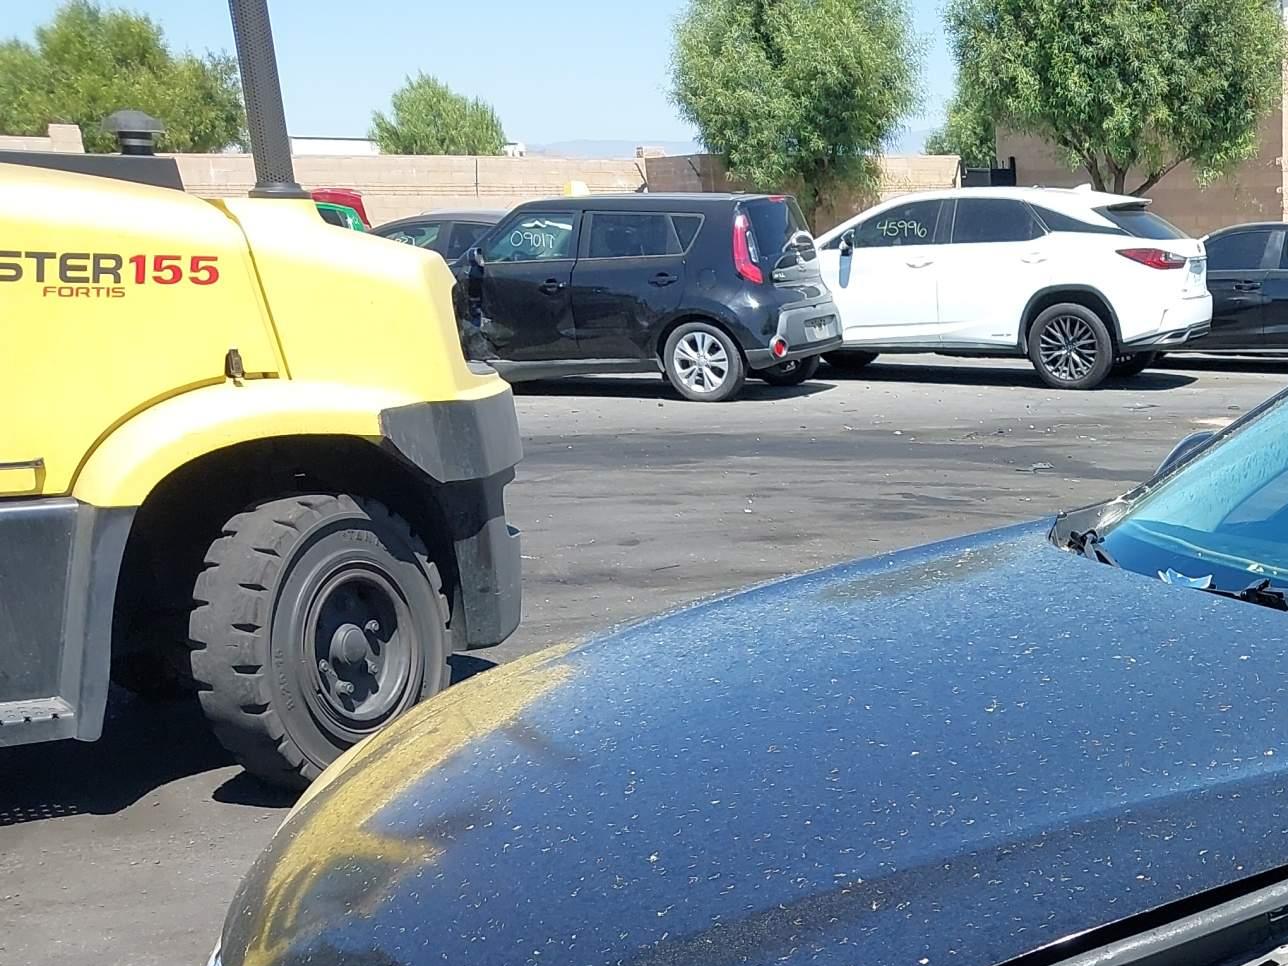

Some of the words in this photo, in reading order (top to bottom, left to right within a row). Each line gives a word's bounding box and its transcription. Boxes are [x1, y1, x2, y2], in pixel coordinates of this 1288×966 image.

[876, 219, 928, 238] 45996
[129, 254, 219, 286] 155
[42, 286, 126, 298] FORTIS
